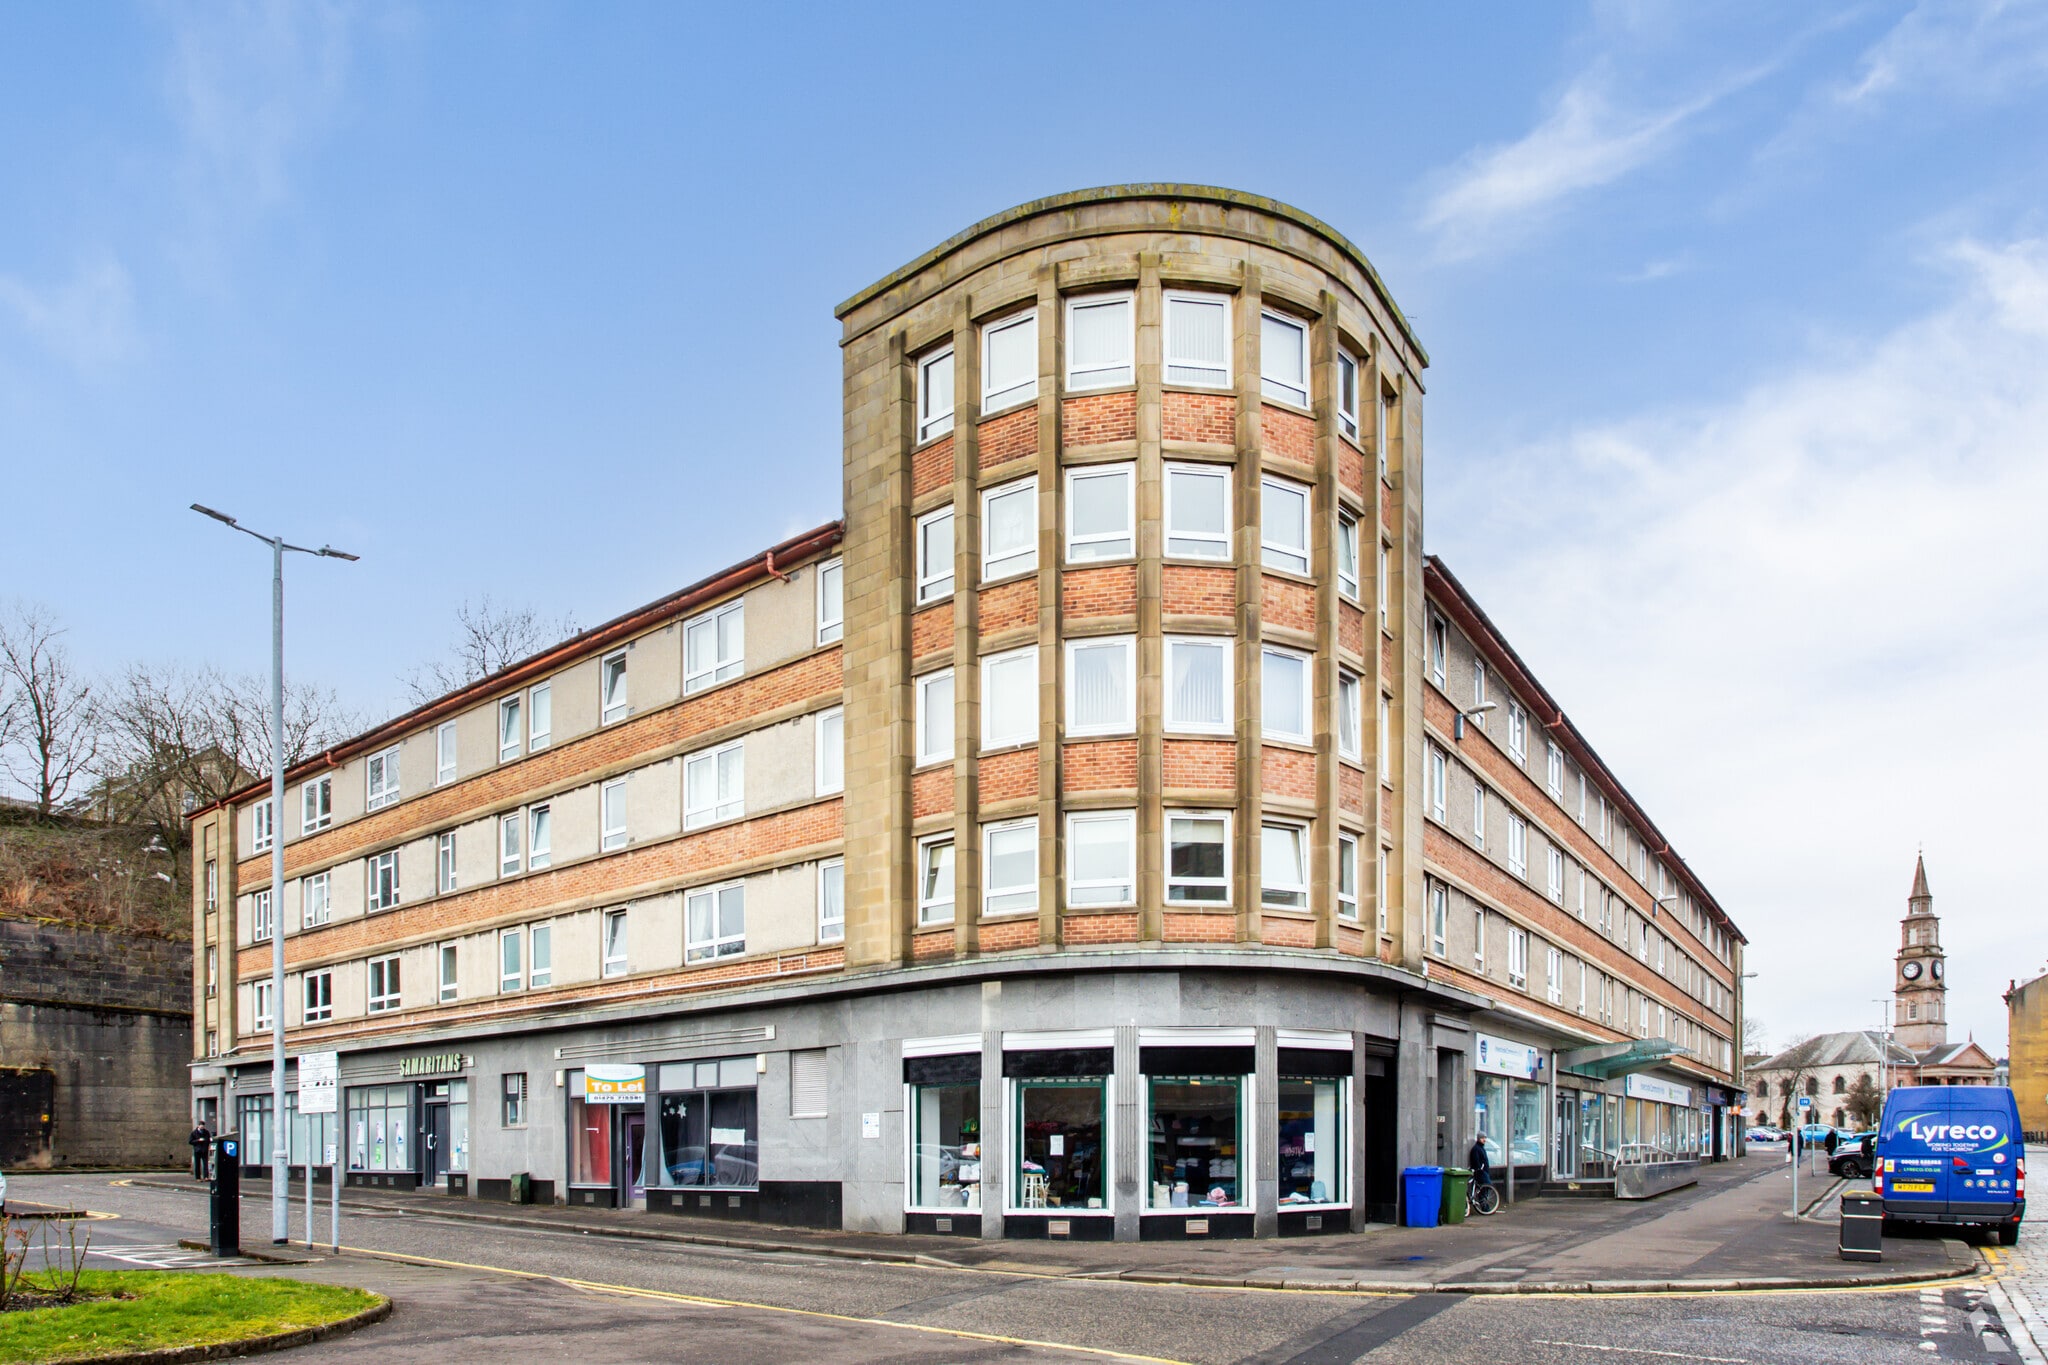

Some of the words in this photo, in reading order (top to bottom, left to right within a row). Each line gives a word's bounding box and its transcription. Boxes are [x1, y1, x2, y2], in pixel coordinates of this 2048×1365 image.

[399, 1053, 461, 1077] SAMARITANS
[591, 1082, 613, 1092] To
[617, 1081, 642, 1092] Let
[1911, 1121, 1997, 1143] Lyreco
[226, 1142, 235, 1154] P
